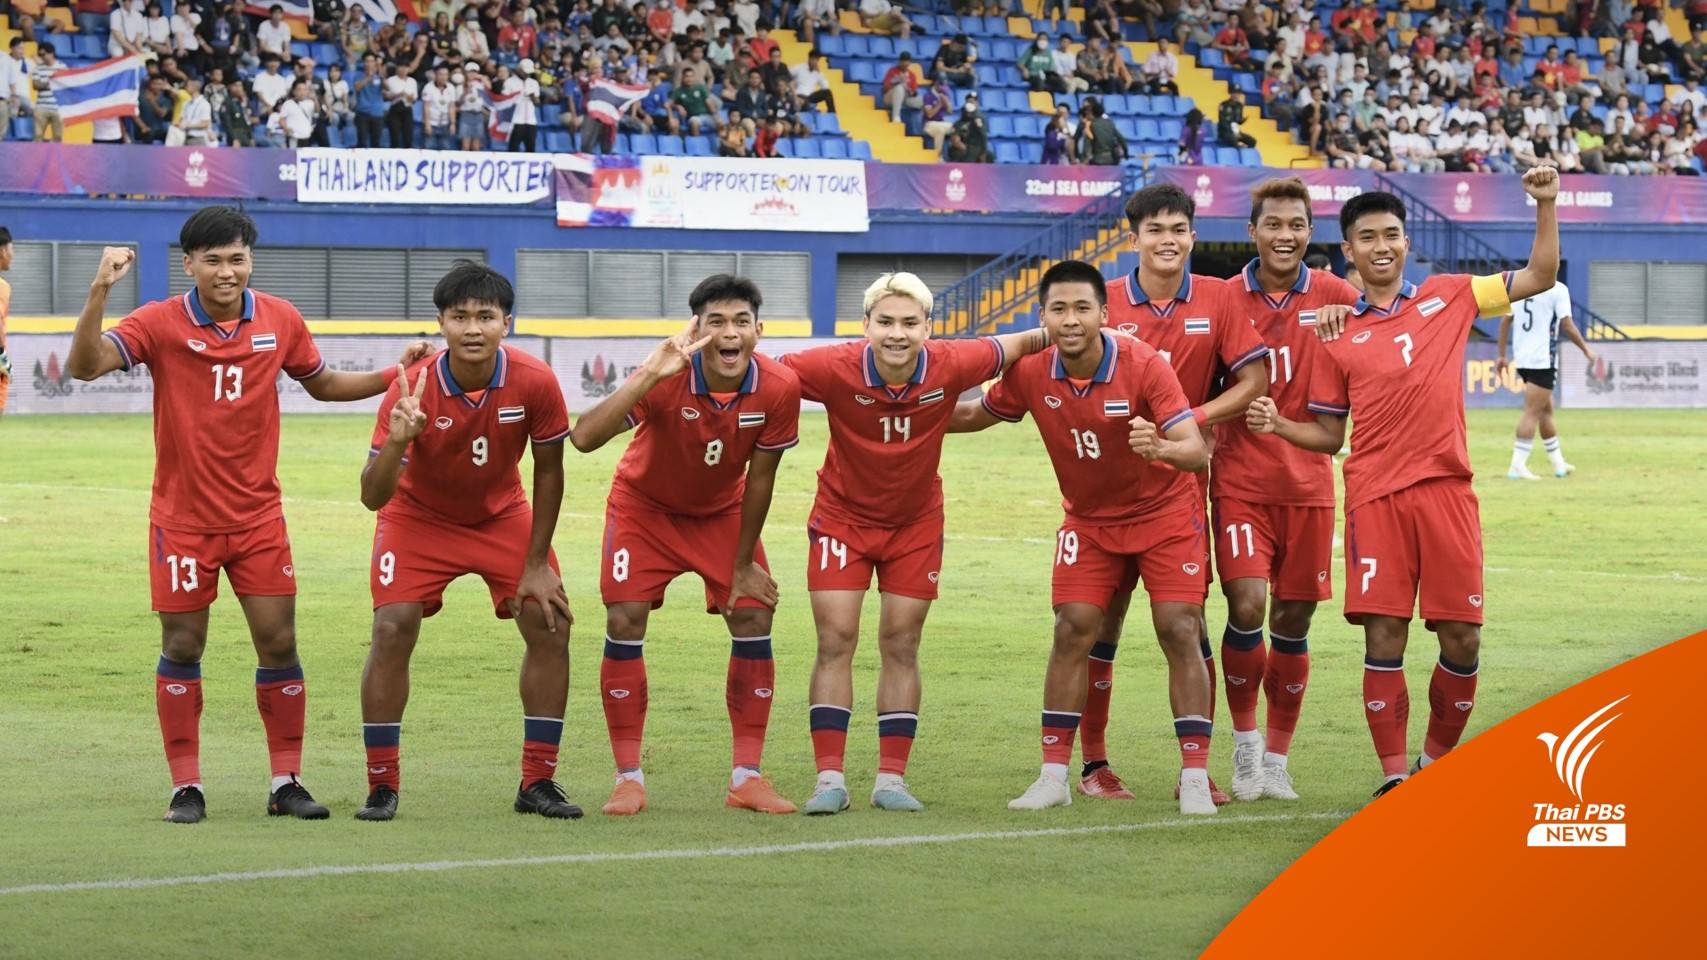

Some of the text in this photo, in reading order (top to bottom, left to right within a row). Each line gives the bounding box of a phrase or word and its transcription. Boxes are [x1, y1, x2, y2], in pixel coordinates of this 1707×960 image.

[300, 157, 553, 193] THAILAND SUPPORTER
[684, 170, 863, 195] SUPPORTER ON TOUR
[1025, 179, 1122, 198] 32nd SEA GAMES
[1575, 191, 1613, 208] GAMES
[1522, 298, 1534, 333] 5
[1265, 345, 1292, 385] 11
[1393, 332, 1414, 368] 7
[211, 364, 243, 402] 13
[879, 416, 911, 443] 14
[1070, 428, 1101, 460] 19
[472, 436, 488, 466] 9
[704, 439, 724, 466] 8
[818, 536, 847, 570] 14
[1056, 530, 1079, 566] 19
[1226, 523, 1255, 558] 11
[166, 555, 199, 593] 13
[379, 551, 396, 587] 9
[612, 548, 630, 583] 8
[1360, 557, 1378, 595] 7
